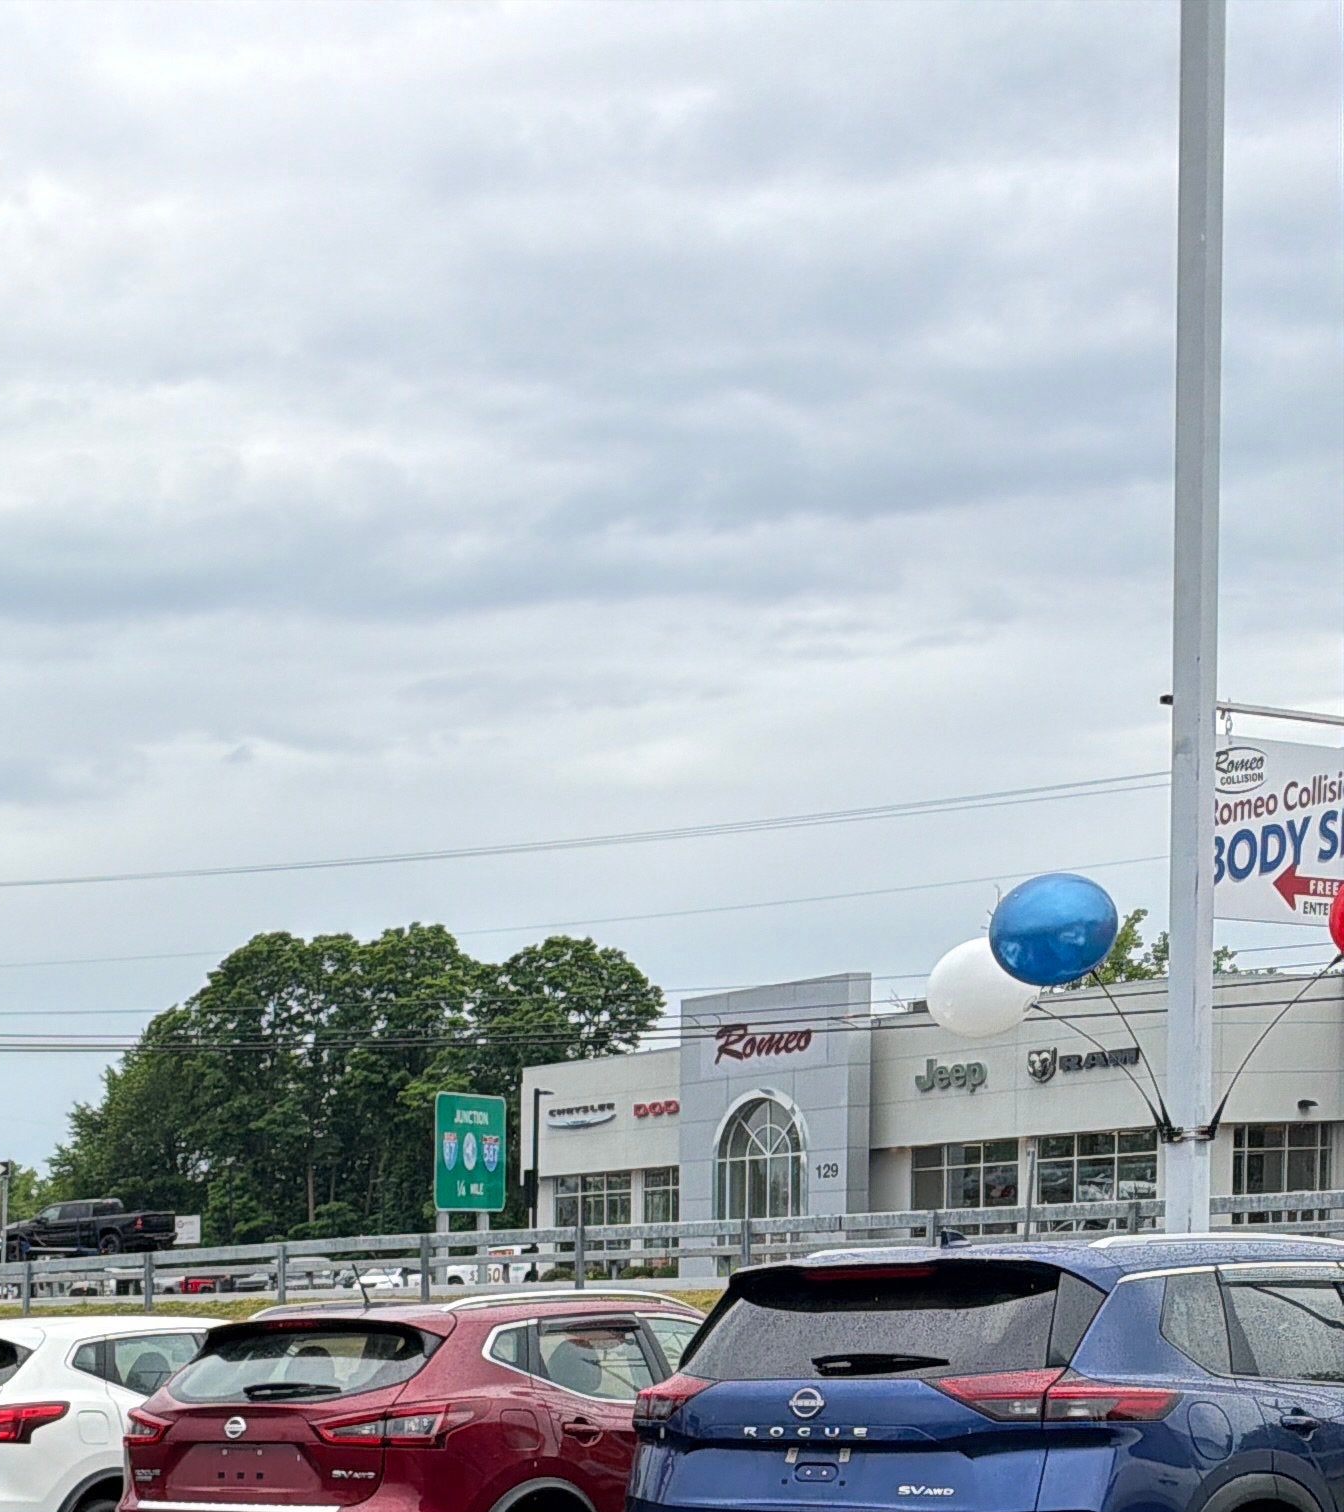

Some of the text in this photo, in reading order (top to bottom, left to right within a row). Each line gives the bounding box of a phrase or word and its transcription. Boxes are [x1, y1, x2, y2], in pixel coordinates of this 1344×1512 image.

[1216, 751, 1264, 774] Romeo
[1220, 772, 1263, 786] COLLISION
[1283, 771, 1344, 811] Collisi
[1318, 807, 1344, 863] S
[1309, 880, 1339, 896] FREE
[1303, 900, 1330, 916] ENTE
[715, 1024, 812, 1065] Romeo
[1059, 1047, 1140, 1072] RAM
[915, 1058, 987, 1093] Jeep
[454, 1109, 489, 1126] JUNCTION
[548, 1102, 615, 1118] CHRYSLER
[815, 1163, 839, 1179] 129
[470, 1182, 484, 1196] MILE
[743, 1426, 868, 1438] ROGUE
[898, 1485, 955, 1496] SV AWD
